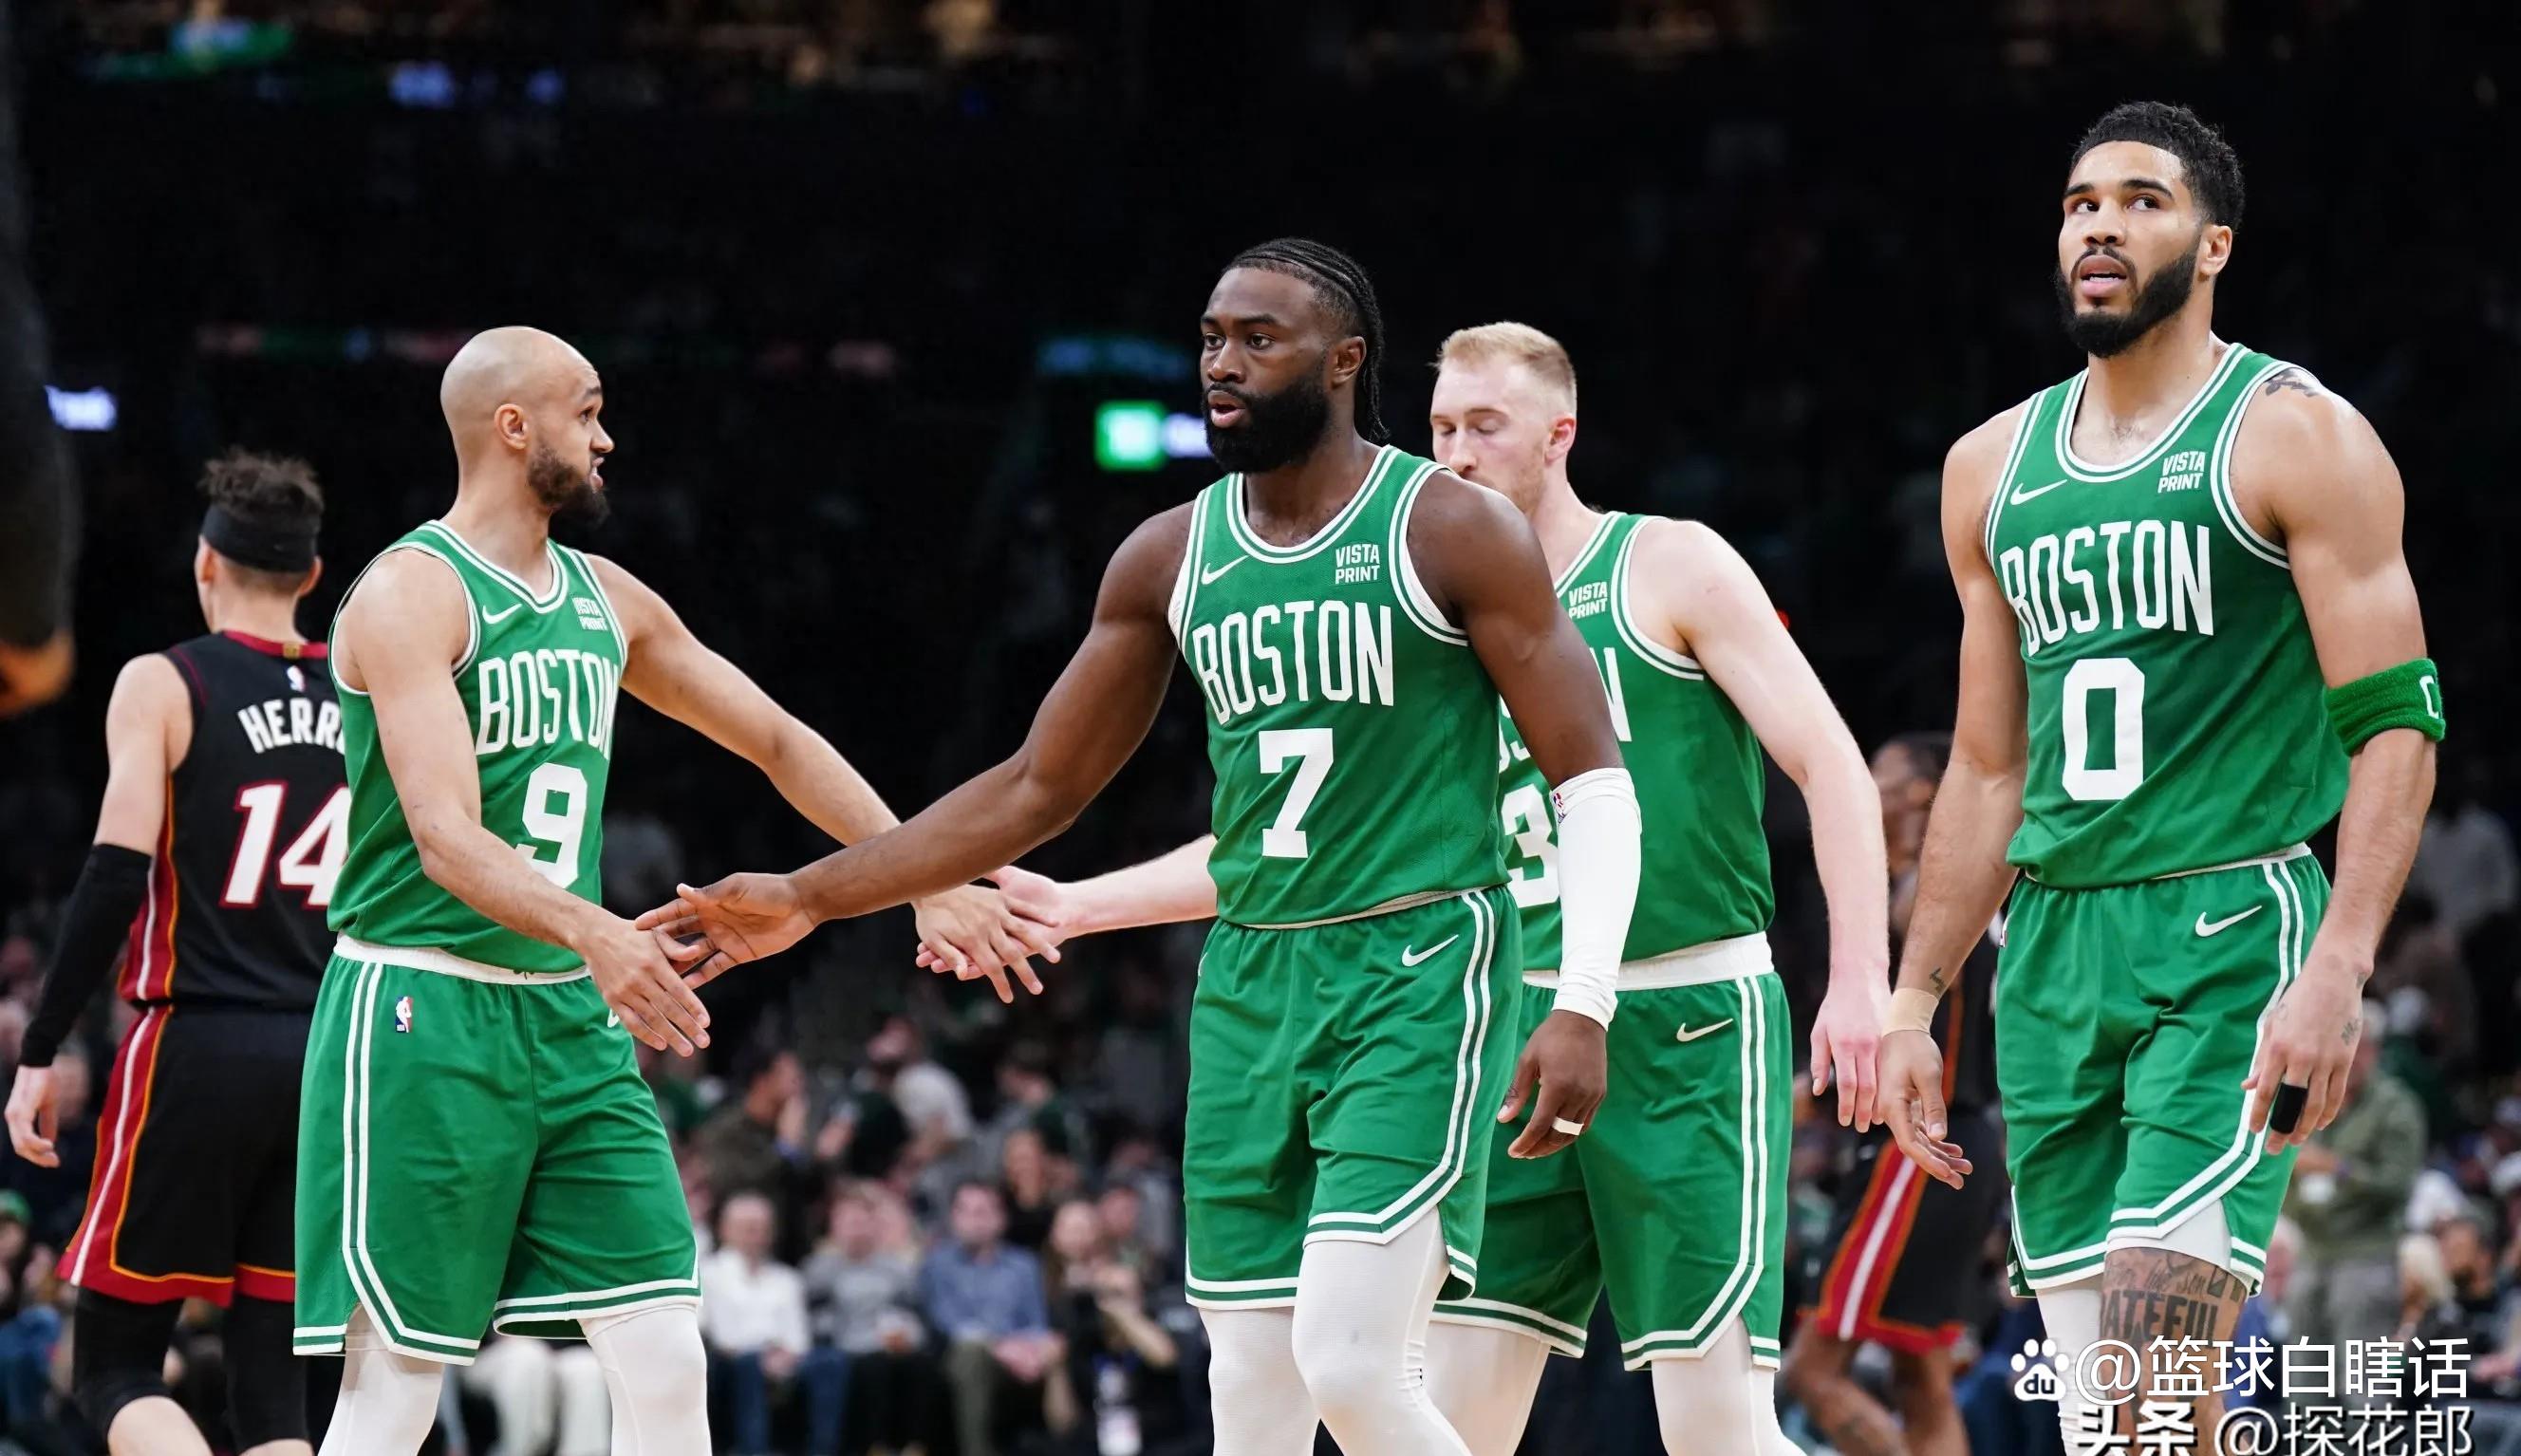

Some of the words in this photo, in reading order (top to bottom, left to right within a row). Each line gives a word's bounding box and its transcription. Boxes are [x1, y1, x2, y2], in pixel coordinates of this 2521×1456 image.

[2157, 473, 2204, 494] PRINT
[2162, 451, 2206, 476] VISTA
[1335, 544, 1380, 568] VISTA
[1335, 566, 1380, 584] PRINT
[1569, 582, 1608, 607] VISTA
[2000, 519, 2214, 657] BOSTON
[1569, 599, 1608, 619] PRINT
[476, 648, 619, 760] BOSTON
[1192, 600, 1394, 725] BOSTON
[237, 697, 345, 755] HERR
[2062, 657, 2146, 801] 0
[515, 762, 588, 889] 9
[1258, 727, 1335, 859] 7
[219, 780, 352, 909] 14
